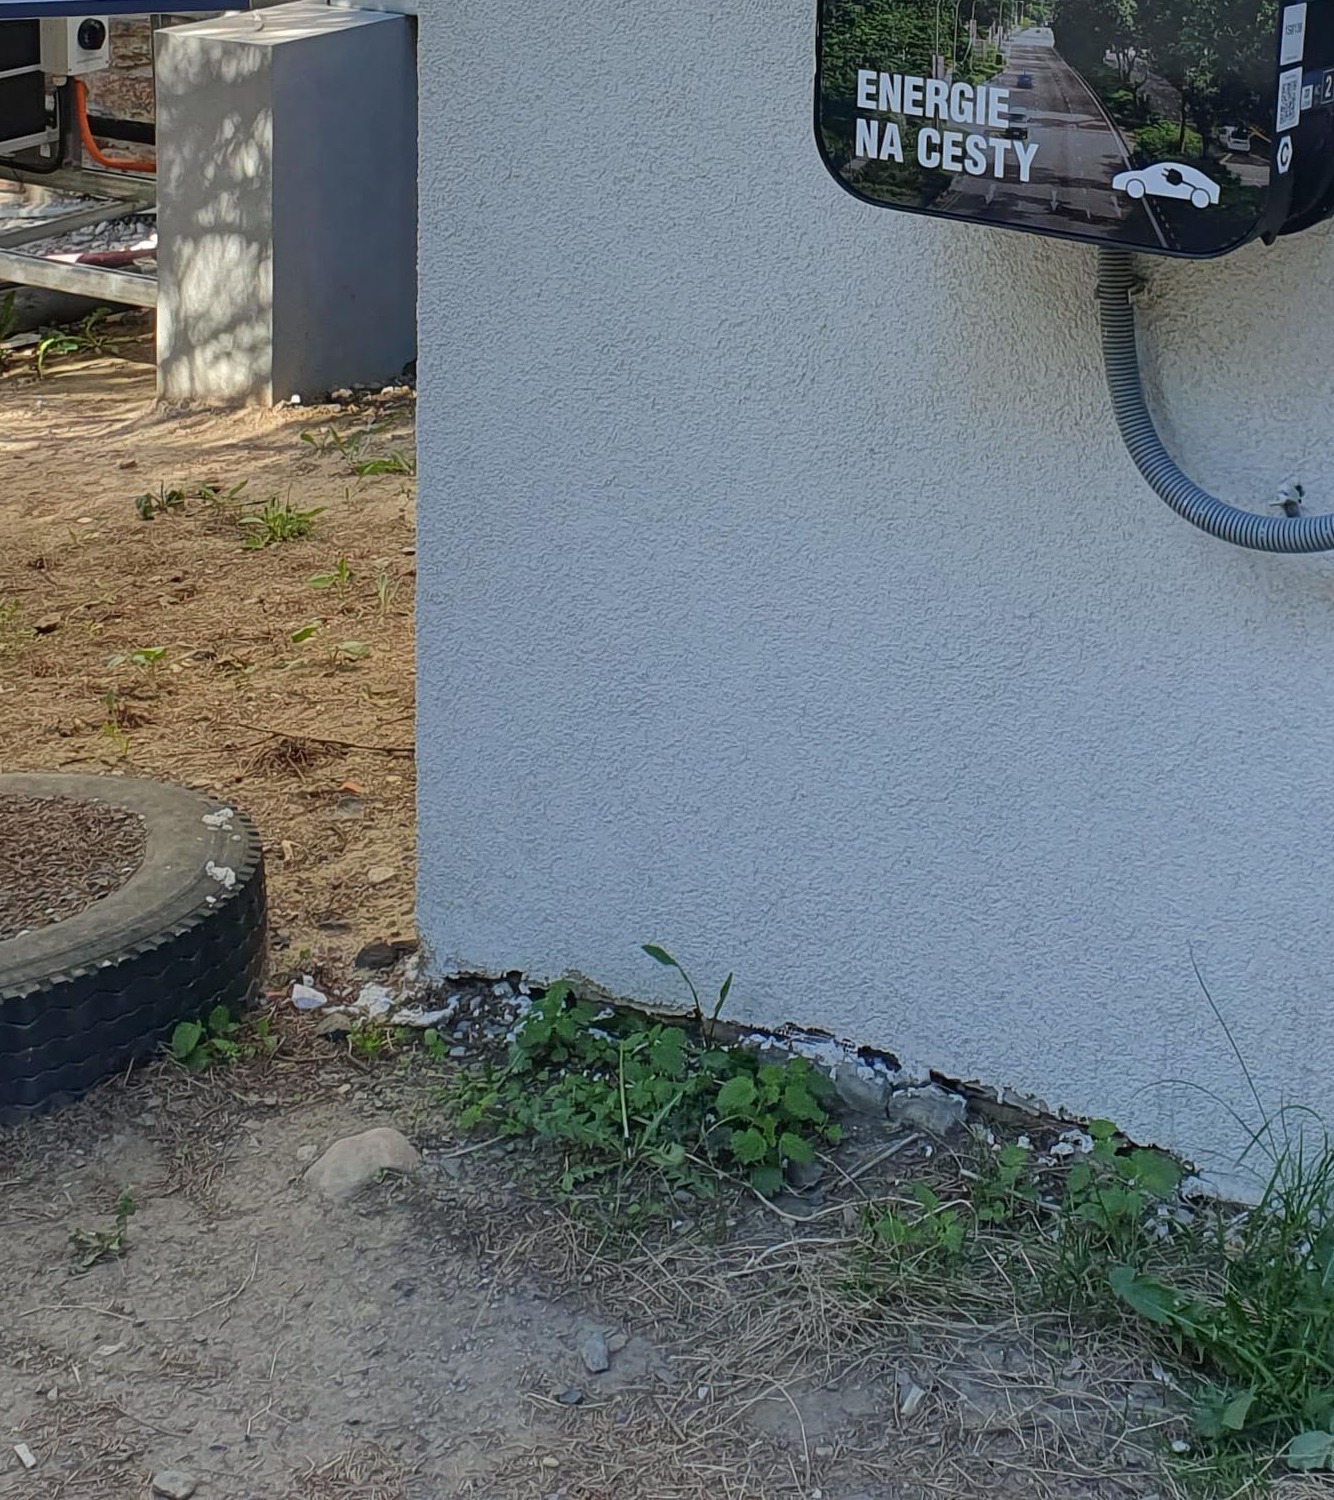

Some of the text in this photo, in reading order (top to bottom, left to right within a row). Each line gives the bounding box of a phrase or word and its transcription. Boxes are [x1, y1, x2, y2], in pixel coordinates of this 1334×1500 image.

[857, 69, 1010, 128] ENERGIE
[1325, 75, 1332, 98] 2
[854, 117, 1039, 183] NA CESTY
